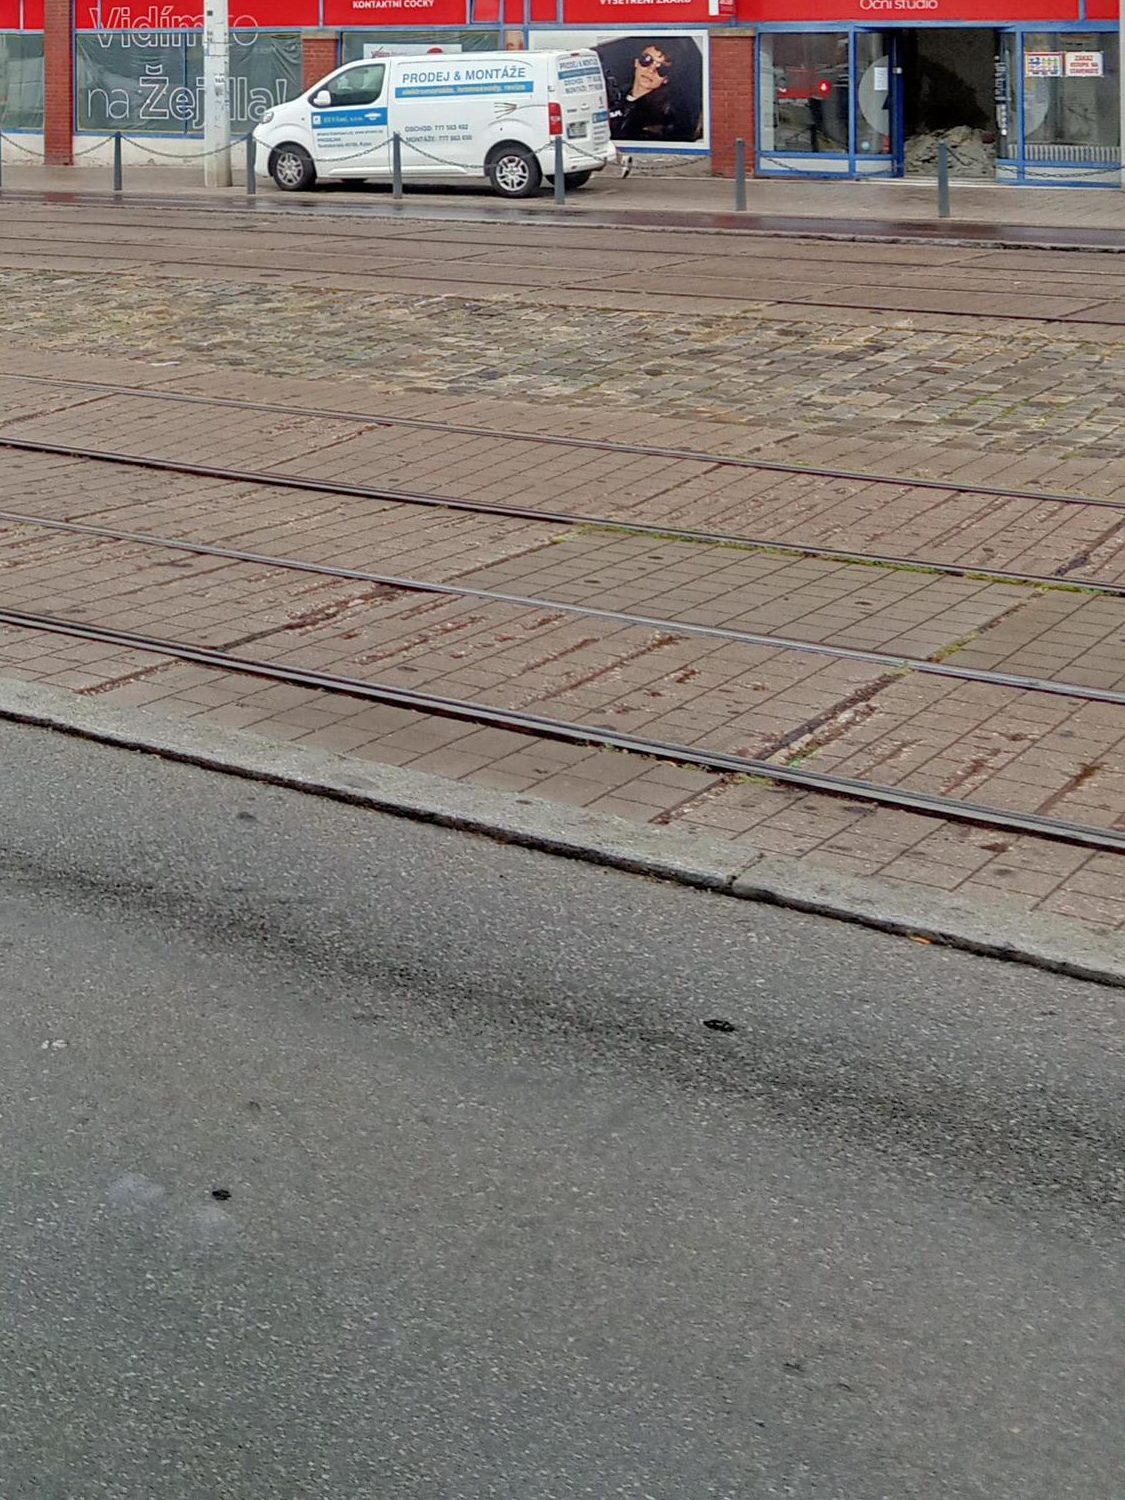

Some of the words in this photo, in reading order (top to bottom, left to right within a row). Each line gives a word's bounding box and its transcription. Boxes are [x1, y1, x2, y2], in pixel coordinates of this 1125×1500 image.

[402, 71, 450, 83] PRODEJ
[453, 70, 461, 80] &
[465, 65, 526, 80] MONTÁŽE
[87, 88, 130, 120] na
